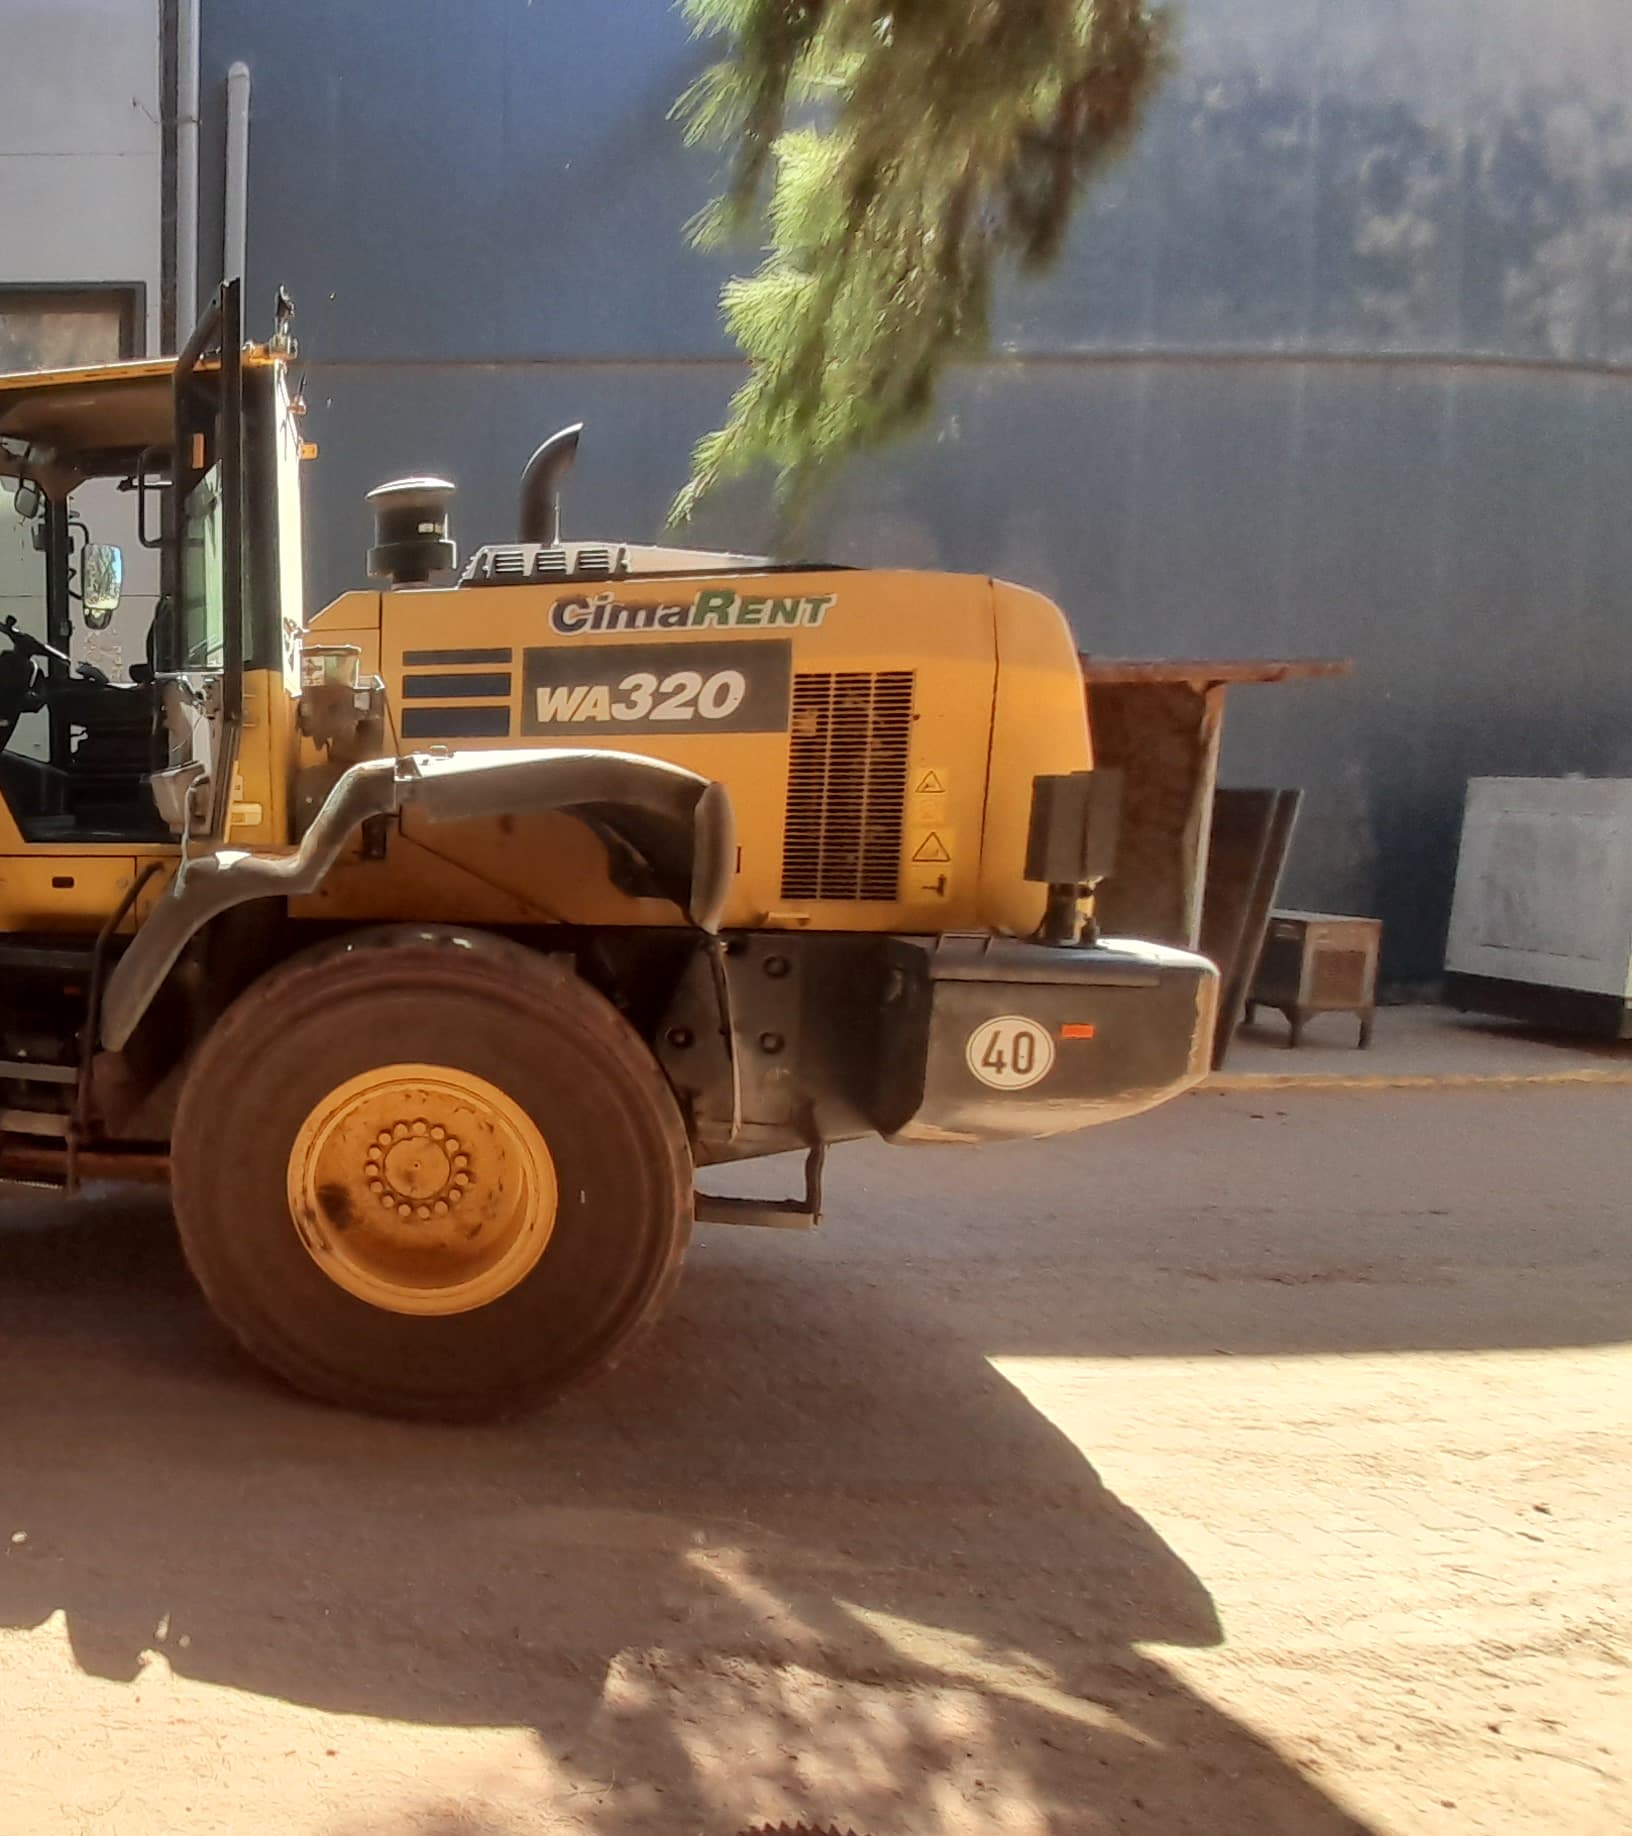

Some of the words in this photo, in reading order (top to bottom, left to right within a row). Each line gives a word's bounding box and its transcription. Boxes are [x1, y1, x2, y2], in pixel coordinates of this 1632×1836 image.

[552, 588, 834, 633] CimaRENT
[536, 670, 747, 722] WA320
[980, 1030, 1036, 1076] 40
